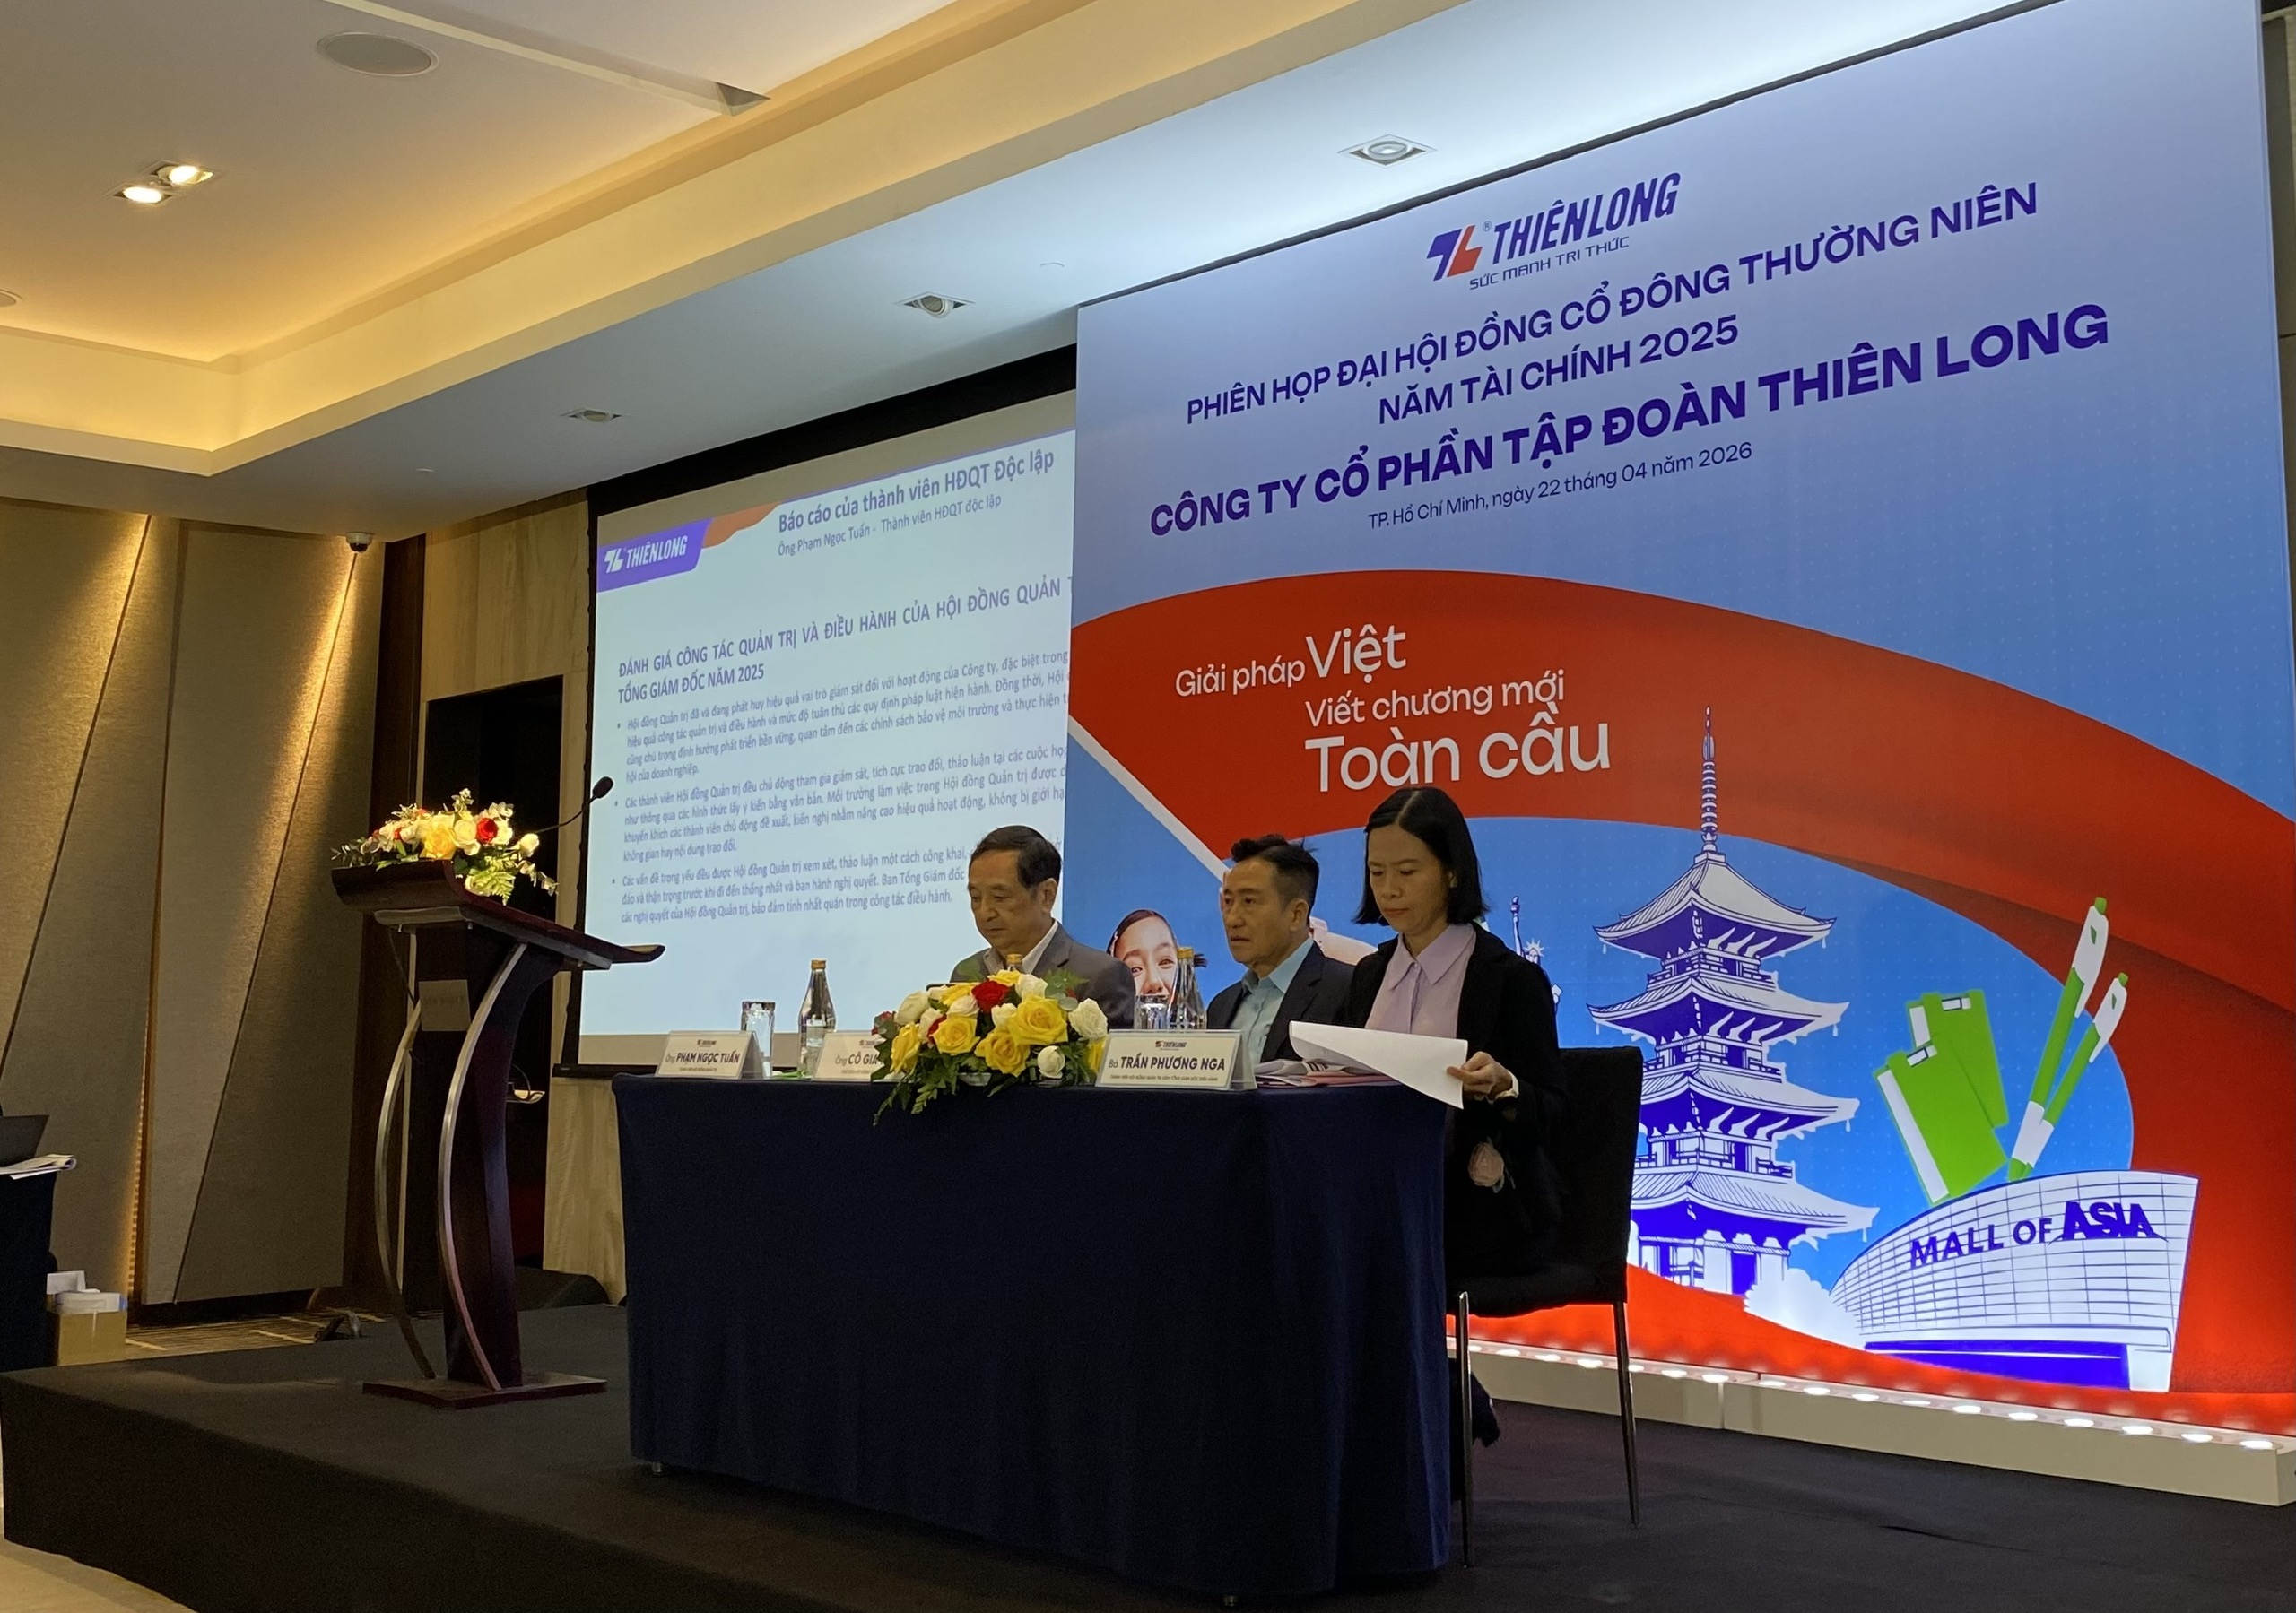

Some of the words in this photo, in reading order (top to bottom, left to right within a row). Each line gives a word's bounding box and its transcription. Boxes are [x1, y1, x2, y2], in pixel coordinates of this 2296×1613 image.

[1492, 173, 1681, 264] THIÊNLONG
[1469, 272, 1498, 290] SỨC
[1555, 249, 1580, 265] TRI
[1585, 236, 1628, 256] THỨC
[1187, 382, 1265, 424] PHIÊN
[1273, 366, 1330, 403] HỌP
[1336, 351, 1387, 386] ĐẠI
[1395, 332, 1446, 373] HỘI
[1454, 309, 1552, 357] ĐỒNG
[1561, 280, 1610, 330] CỔ
[1619, 264, 1729, 317] ĐÔNG
[1739, 215, 1918, 284] THƯỜNG
[1931, 182, 2036, 238] NIÊN
[1379, 382, 1452, 424] NĂM
[1460, 365, 1511, 403] TÀI
[1521, 340, 1630, 390] CHÍNH
[1639, 314, 1737, 363] 2025
[1151, 488, 1249, 535] CÔNG
[1257, 473, 1306, 513] TY
[1314, 445, 1369, 502] CỔ
[1378, 427, 1492, 490] PHẦN
[1502, 412, 1592, 469] TẬP
[1602, 380, 1745, 446] ĐOÀN
[1758, 342, 1921, 411] THIÊN
[1936, 304, 2108, 377] LONG
[778, 509, 804, 533] Báo
[807, 503, 831, 525] cáo
[834, 495, 858, 518] của
[862, 484, 904, 512] thành
[909, 477, 939, 500] viên
[944, 463, 990, 492] HĐQT
[994, 455, 1024, 481] Độc
[1030, 448, 1054, 474] lập
[778, 540, 795, 556] Ông
[797, 537, 822, 551] Phạm
[823, 532, 846, 547] Ngọc
[848, 522, 870, 540] Tuấn
[881, 514, 909, 533] Thành
[911, 509, 931, 525] viên
[934, 500, 963, 520] HĐQT
[965, 498, 983, 513] độc
[986, 493, 1001, 509] lập
[1368, 511, 1388, 529] TP.
[1393, 504, 1413, 525] Hồ
[1417, 500, 1442, 519] Chí
[1446, 494, 1488, 515] Minh,
[1492, 485, 1535, 507] ngày
[1538, 479, 1560, 498] 22
[1563, 471, 1616, 492] tháng
[1622, 462, 1647, 481] 04
[1651, 455, 1693, 476] năm
[1699, 441, 1751, 467] 2026
[626, 535, 688, 568] THIÊNLONG
[618, 657, 648, 677] ĐÁNH
[653, 649, 672, 671] GIÁ
[676, 646, 707, 666] CÔNG
[712, 638, 734, 660] TÁC
[738, 629, 772, 656] QUẢN
[778, 629, 796, 648] TRỊ
[802, 620, 818, 643] VÀ
[824, 613, 853, 639] ĐIỀU
[859, 610, 896, 632] HÀNH
[902, 599, 930, 624] CỦA
[936, 594, 960, 620] HỘI
[967, 586, 1009, 612] ĐỒNG
[1016, 574, 1060, 604] QUẢN
[1175, 664, 1226, 697] Giải
[1233, 656, 1306, 695] pháp
[1305, 624, 1406, 683] Việt
[618, 680, 647, 703] TỔNG
[649, 677, 678, 698] GIÁM
[681, 668, 705, 692] ĐỐC
[708, 666, 735, 688] NĂM
[737, 663, 764, 682] 2025
[1305, 689, 1365, 727] Viết
[1372, 684, 1493, 721] chương
[1502, 669, 1564, 707] mới
[1305, 727, 1461, 793] Toàn
[1479, 701, 1610, 779] cầu
[1150, 1056, 1197, 1070] PHƯƠNG
[1200, 1057, 1225, 1071] NGA
[1910, 1224, 2004, 1270] MALL
[2013, 1218, 2052, 1244] OF
[2061, 1201, 2160, 1243] ASIA
